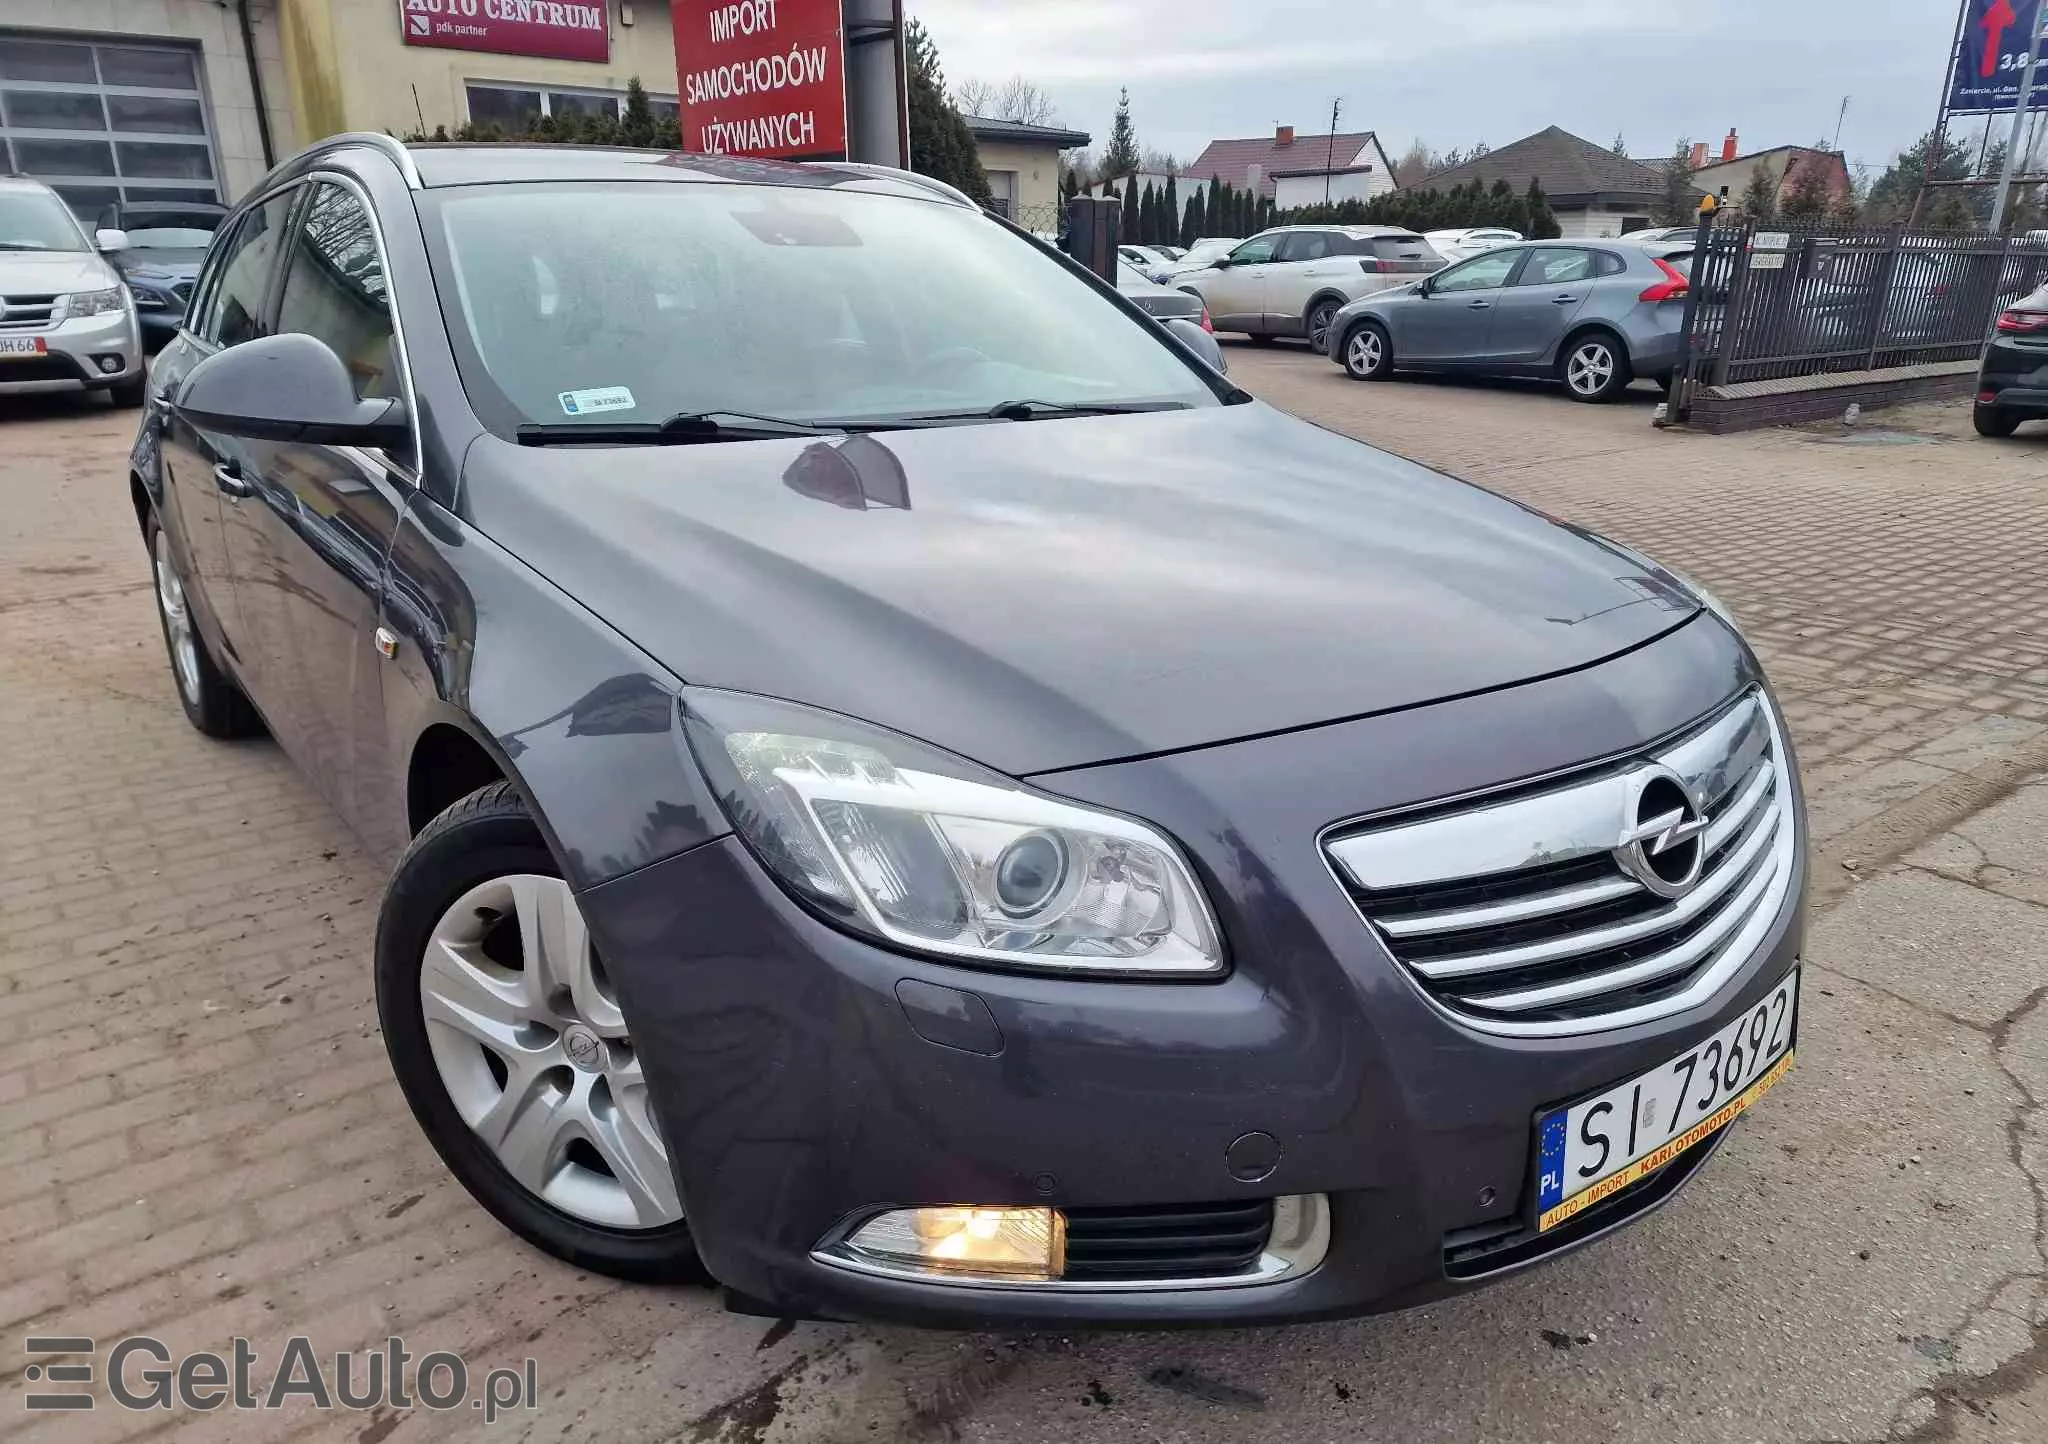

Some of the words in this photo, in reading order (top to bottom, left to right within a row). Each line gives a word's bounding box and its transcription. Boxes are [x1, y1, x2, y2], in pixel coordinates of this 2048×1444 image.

[454, 25, 489, 37] partner
[484, 0, 602, 31] CENTRUM
[709, 0, 776, 43] IMPORT
[685, 42, 827, 105] SAMOCHODÓW
[1999, 52, 2030, 72] 3,8
[701, 110, 815, 154] UŻYWANYCH
[1577, 1084, 1641, 1178] SI
[1668, 987, 1788, 1134] 73692
[1545, 1199, 1578, 1228] AUTO
[1586, 1170, 1630, 1204] IMPORT
[1640, 1097, 1746, 1175] KARI.OTOMOTO.PL
[1539, 1173, 1561, 1198] PL
